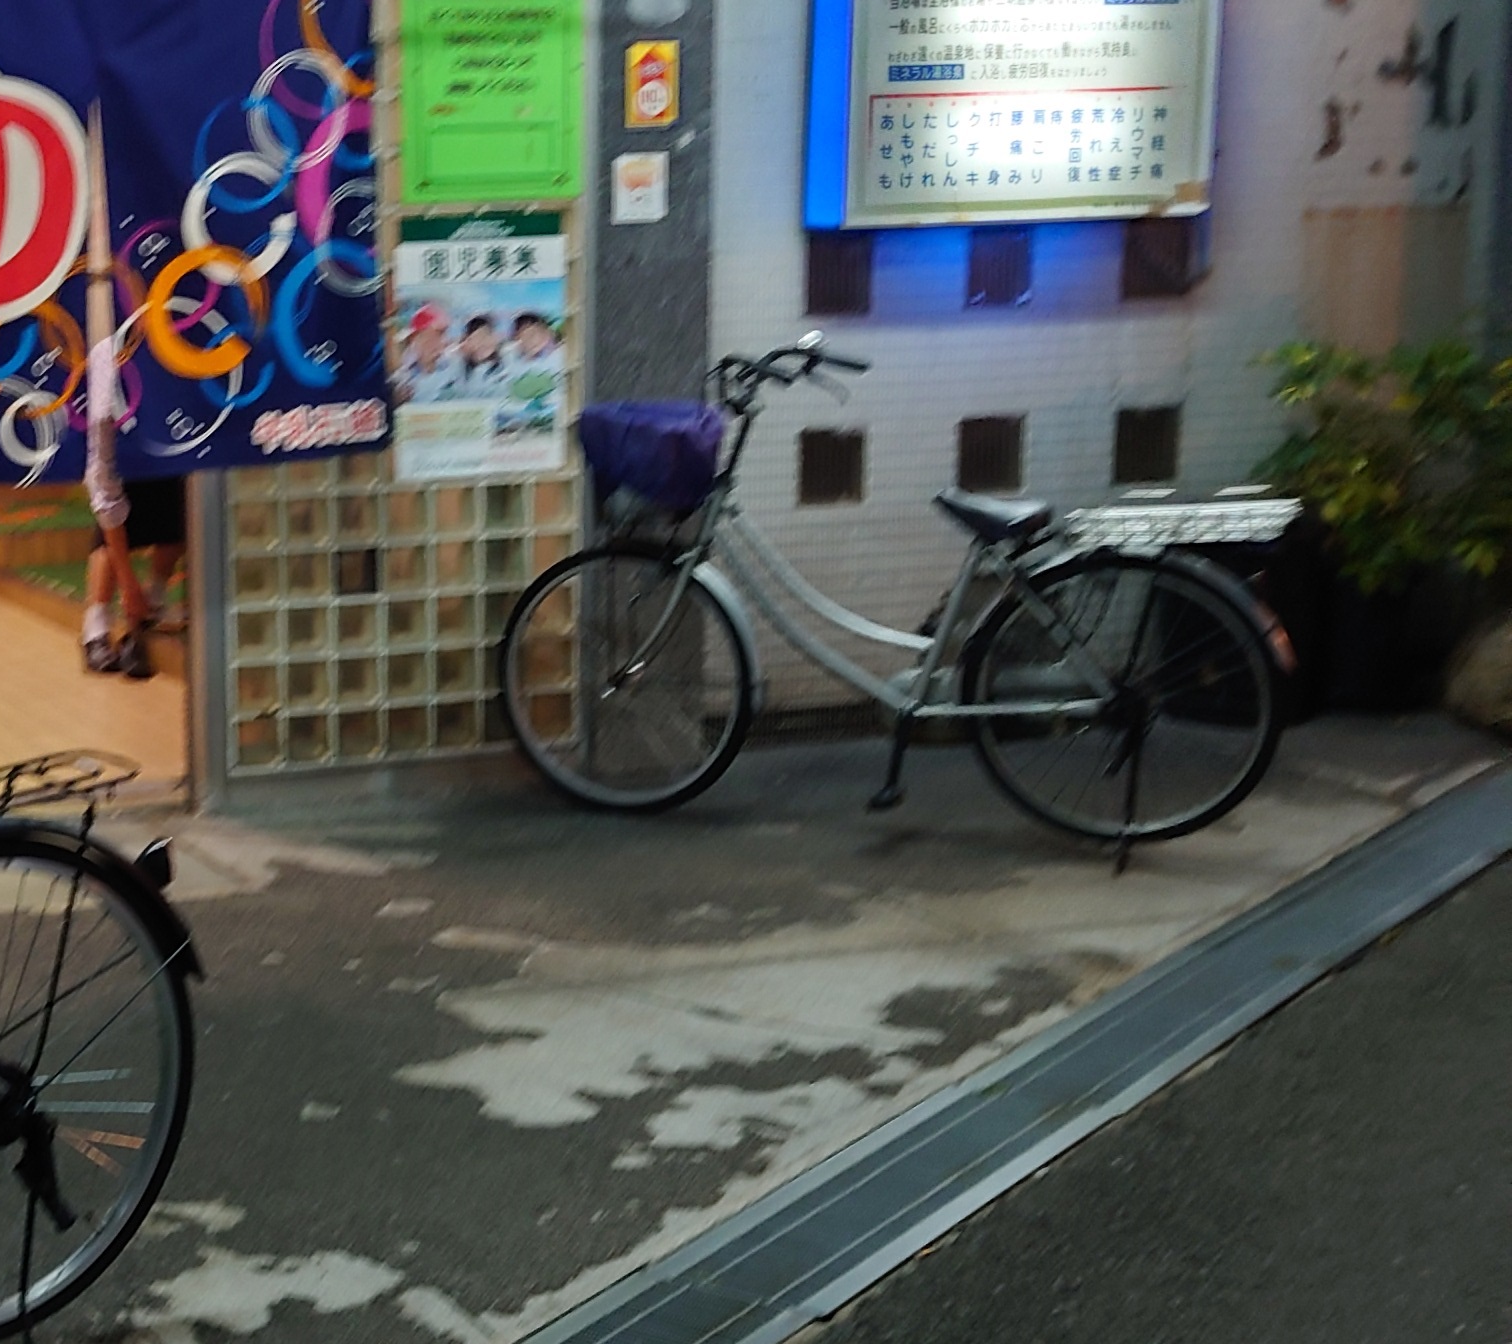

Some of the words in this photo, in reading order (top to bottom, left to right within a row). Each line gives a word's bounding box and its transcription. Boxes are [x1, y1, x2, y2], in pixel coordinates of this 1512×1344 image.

[879, 114, 895, 189] あせも
[900, 113, 915, 189] しもやけ
[921, 112, 938, 188] ただれ
[943, 112, 959, 187] しっしん
[1129, 107, 1145, 180] リウマチ
